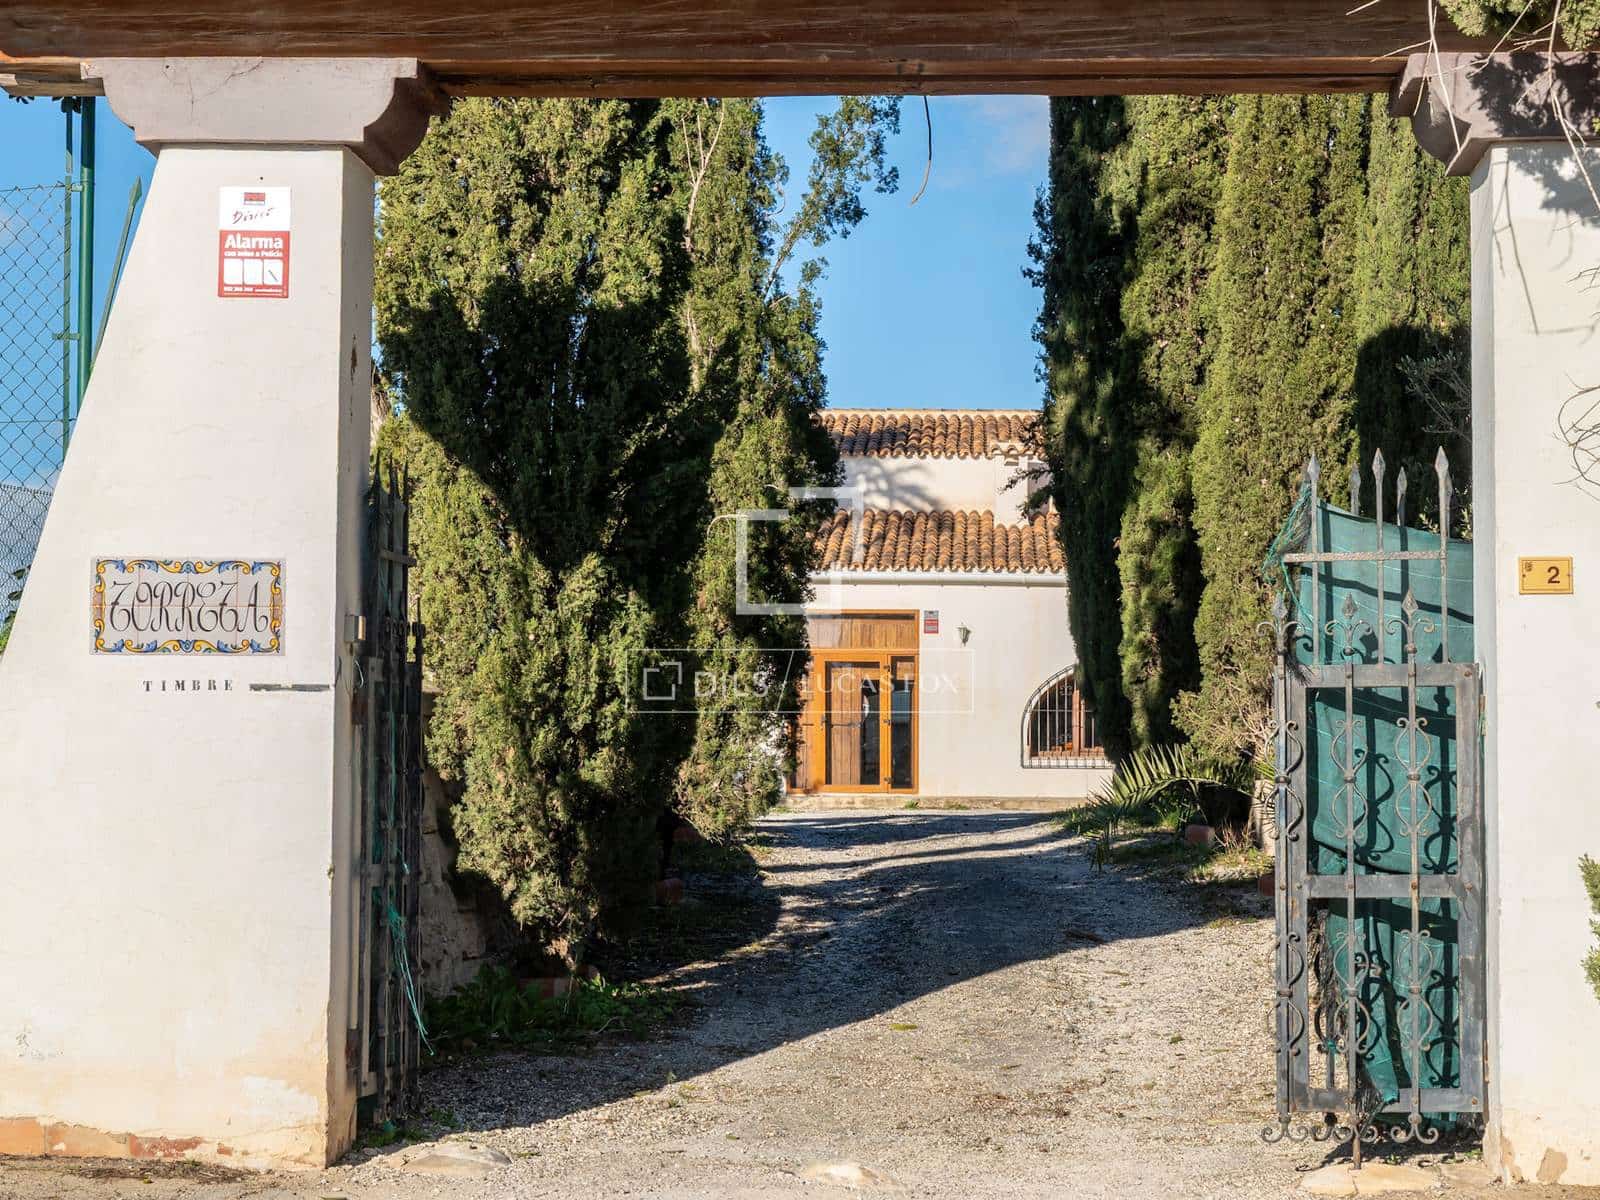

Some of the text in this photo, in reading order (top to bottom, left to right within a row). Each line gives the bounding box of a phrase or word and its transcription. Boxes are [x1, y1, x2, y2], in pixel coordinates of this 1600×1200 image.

[225, 232, 283, 249] Alarma
[1547, 565, 1561, 585] 2
[142, 679, 233, 692] TIMBRE
